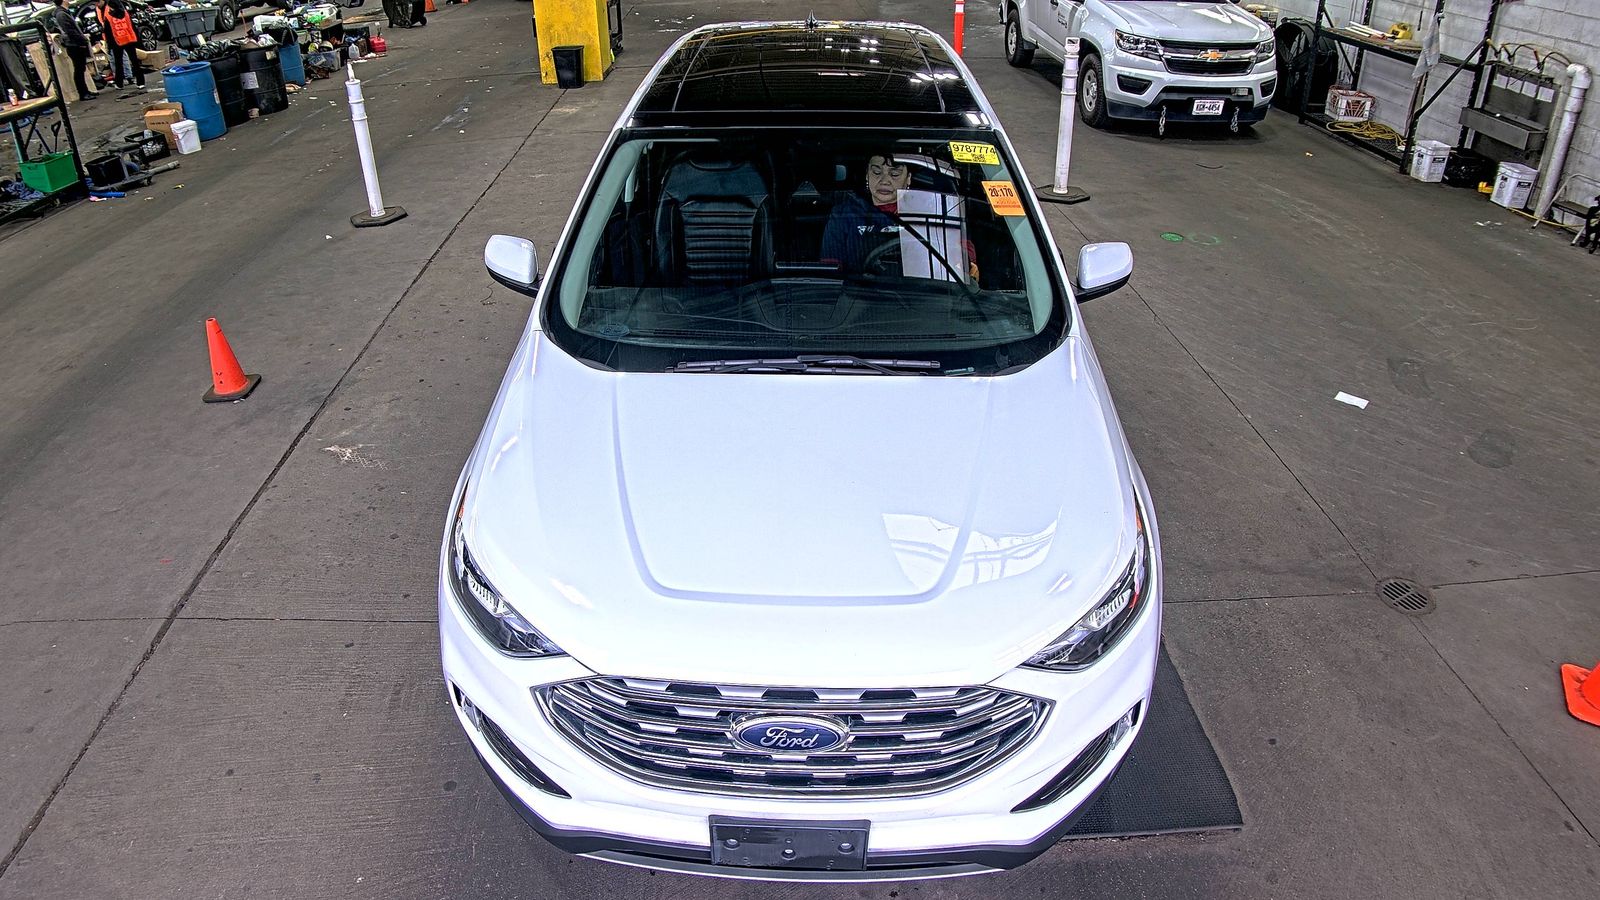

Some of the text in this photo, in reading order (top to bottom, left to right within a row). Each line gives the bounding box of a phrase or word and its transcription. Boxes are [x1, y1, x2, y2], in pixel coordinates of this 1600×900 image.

[952, 143, 996, 154] 9787774
[988, 187, 1014, 197] 20:170
[760, 726, 820, 748] Ford
